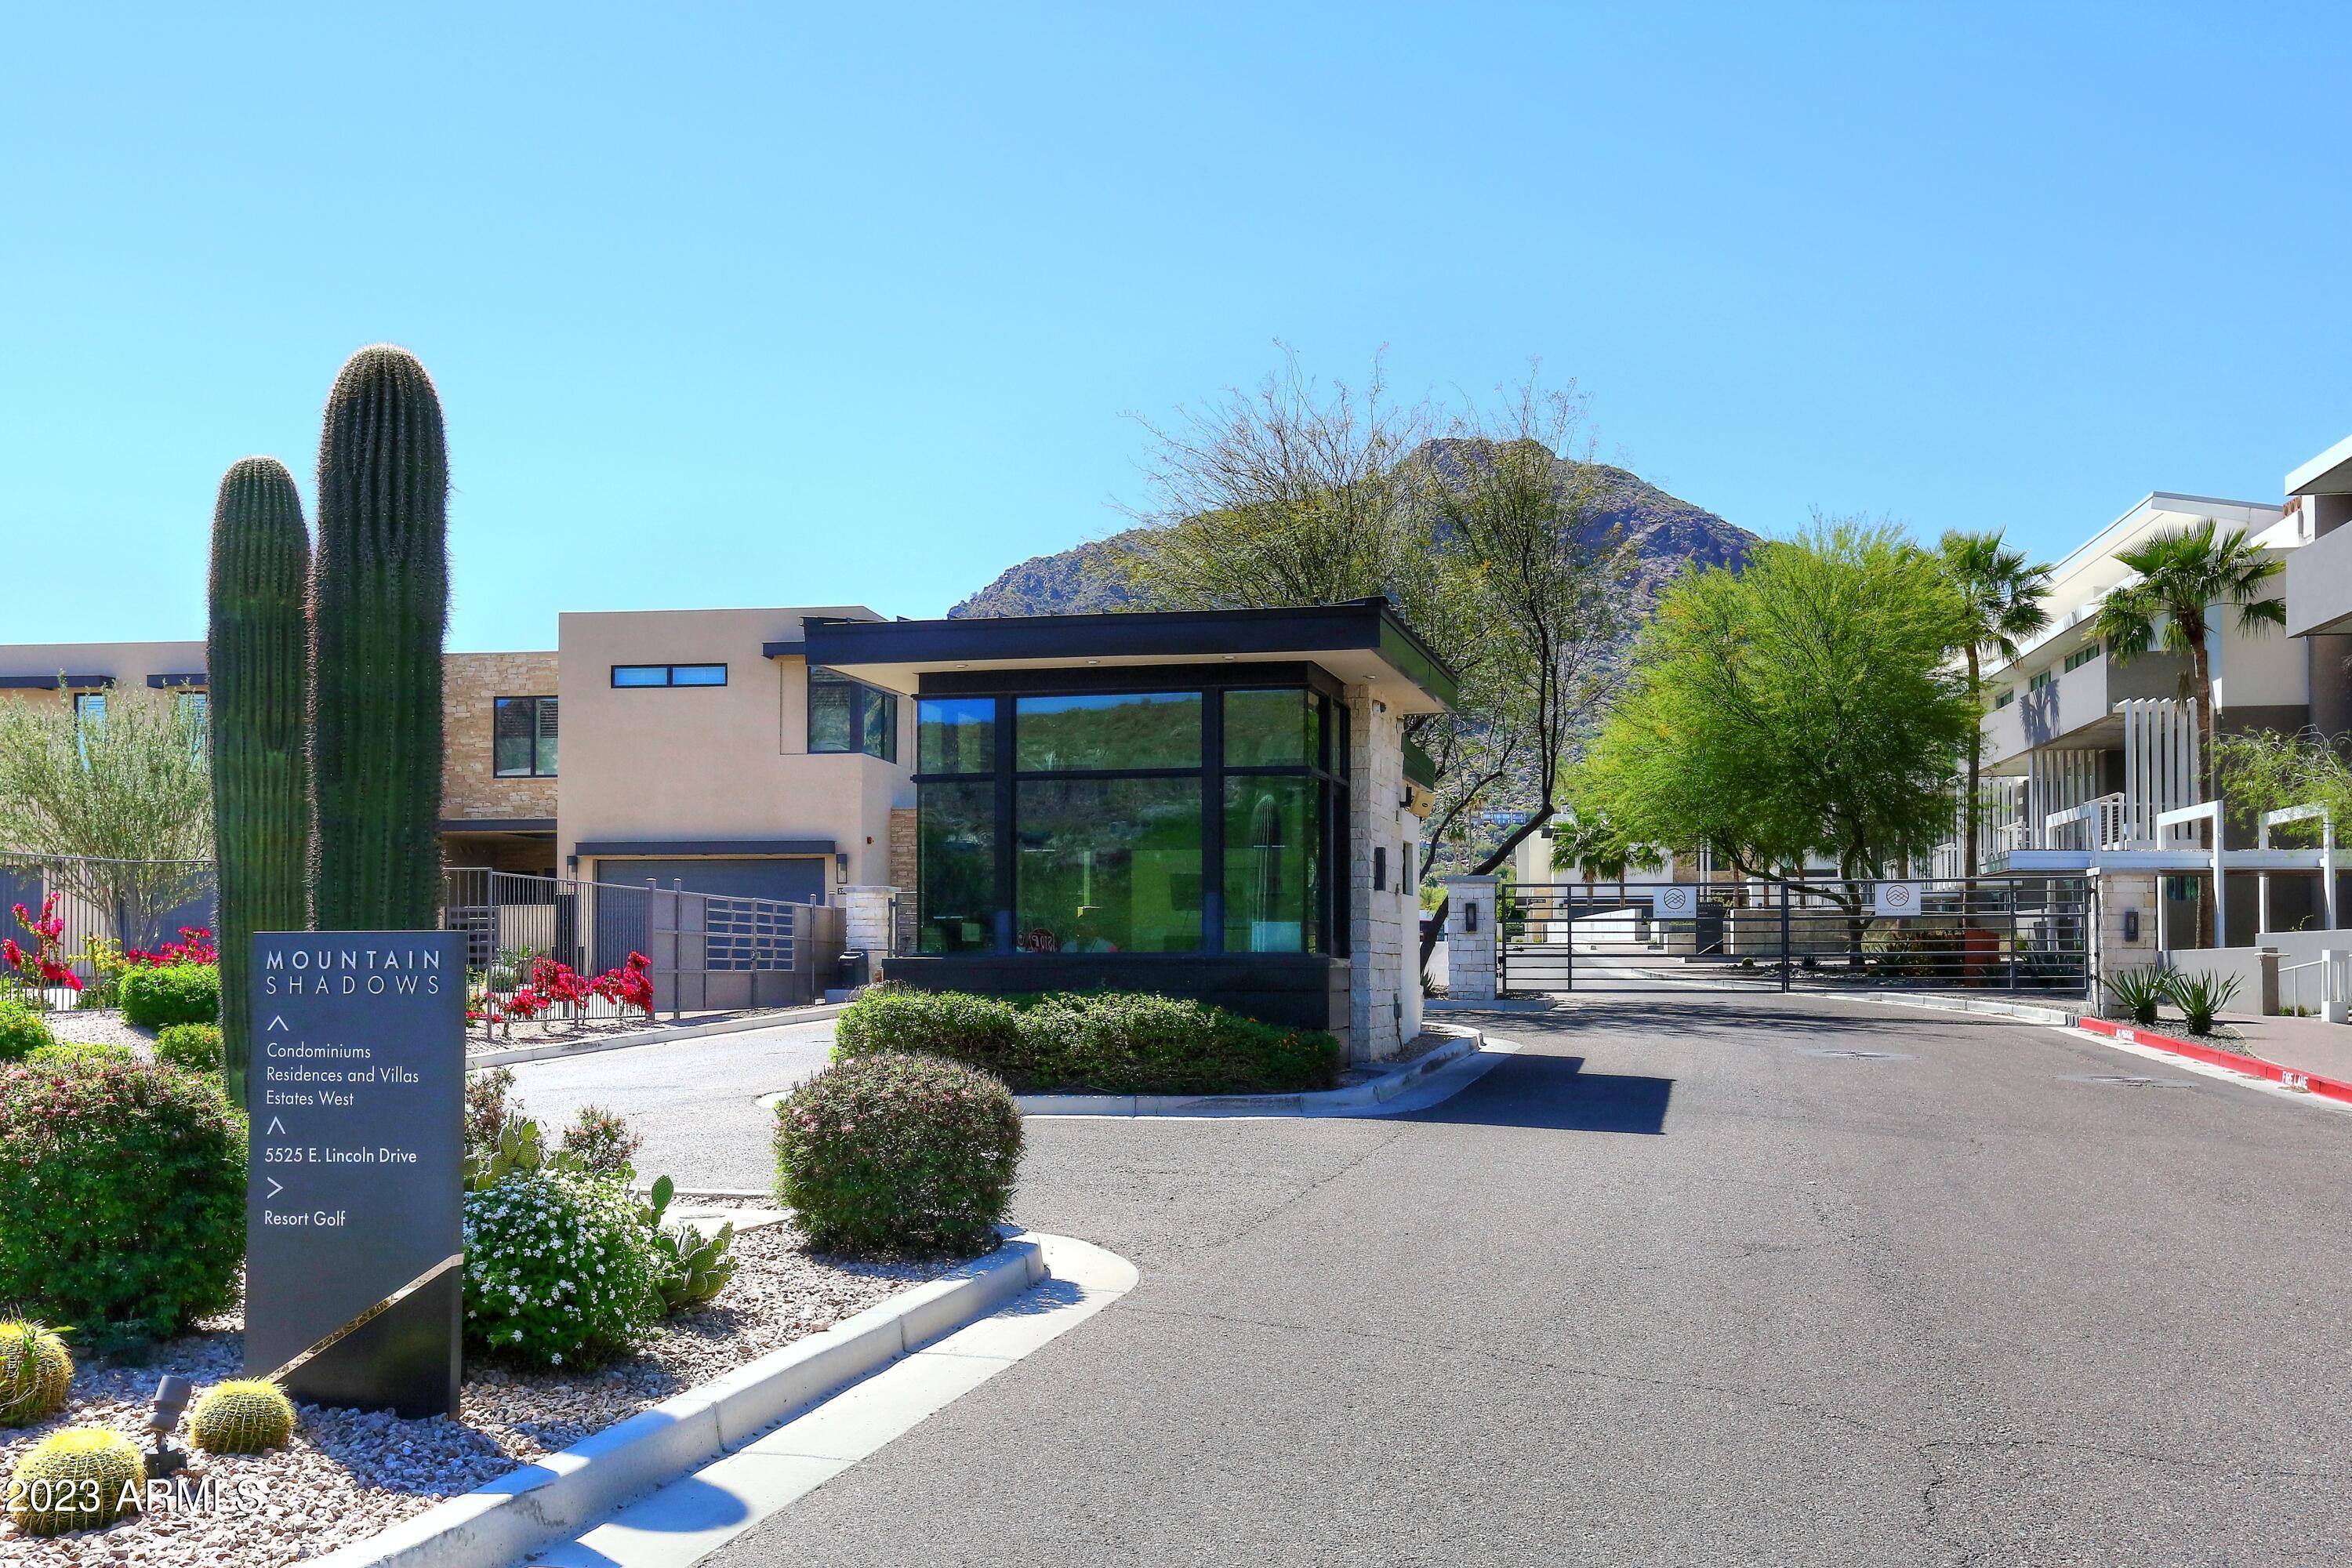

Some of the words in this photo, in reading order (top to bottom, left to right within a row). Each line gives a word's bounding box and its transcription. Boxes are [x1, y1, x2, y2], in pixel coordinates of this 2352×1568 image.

[266, 949, 439, 970] MOUNTAIN
[266, 975, 439, 995] SHADOWS
[267, 1040, 371, 1058] Condominiums
[267, 1065, 343, 1082] Residences
[347, 1065, 375, 1083] and
[380, 1065, 419, 1083] Villas
[2282, 1070, 2294, 1086] FIRE
[267, 1090, 314, 1105] Estates
[318, 1090, 354, 1106] West
[264, 1147, 303, 1163] 5525
[309, 1147, 321, 1163] E.
[325, 1146, 375, 1163] Lincoln
[380, 1147, 417, 1163] Drive
[264, 1210, 309, 1225] Resort
[314, 1210, 346, 1226] Golf
